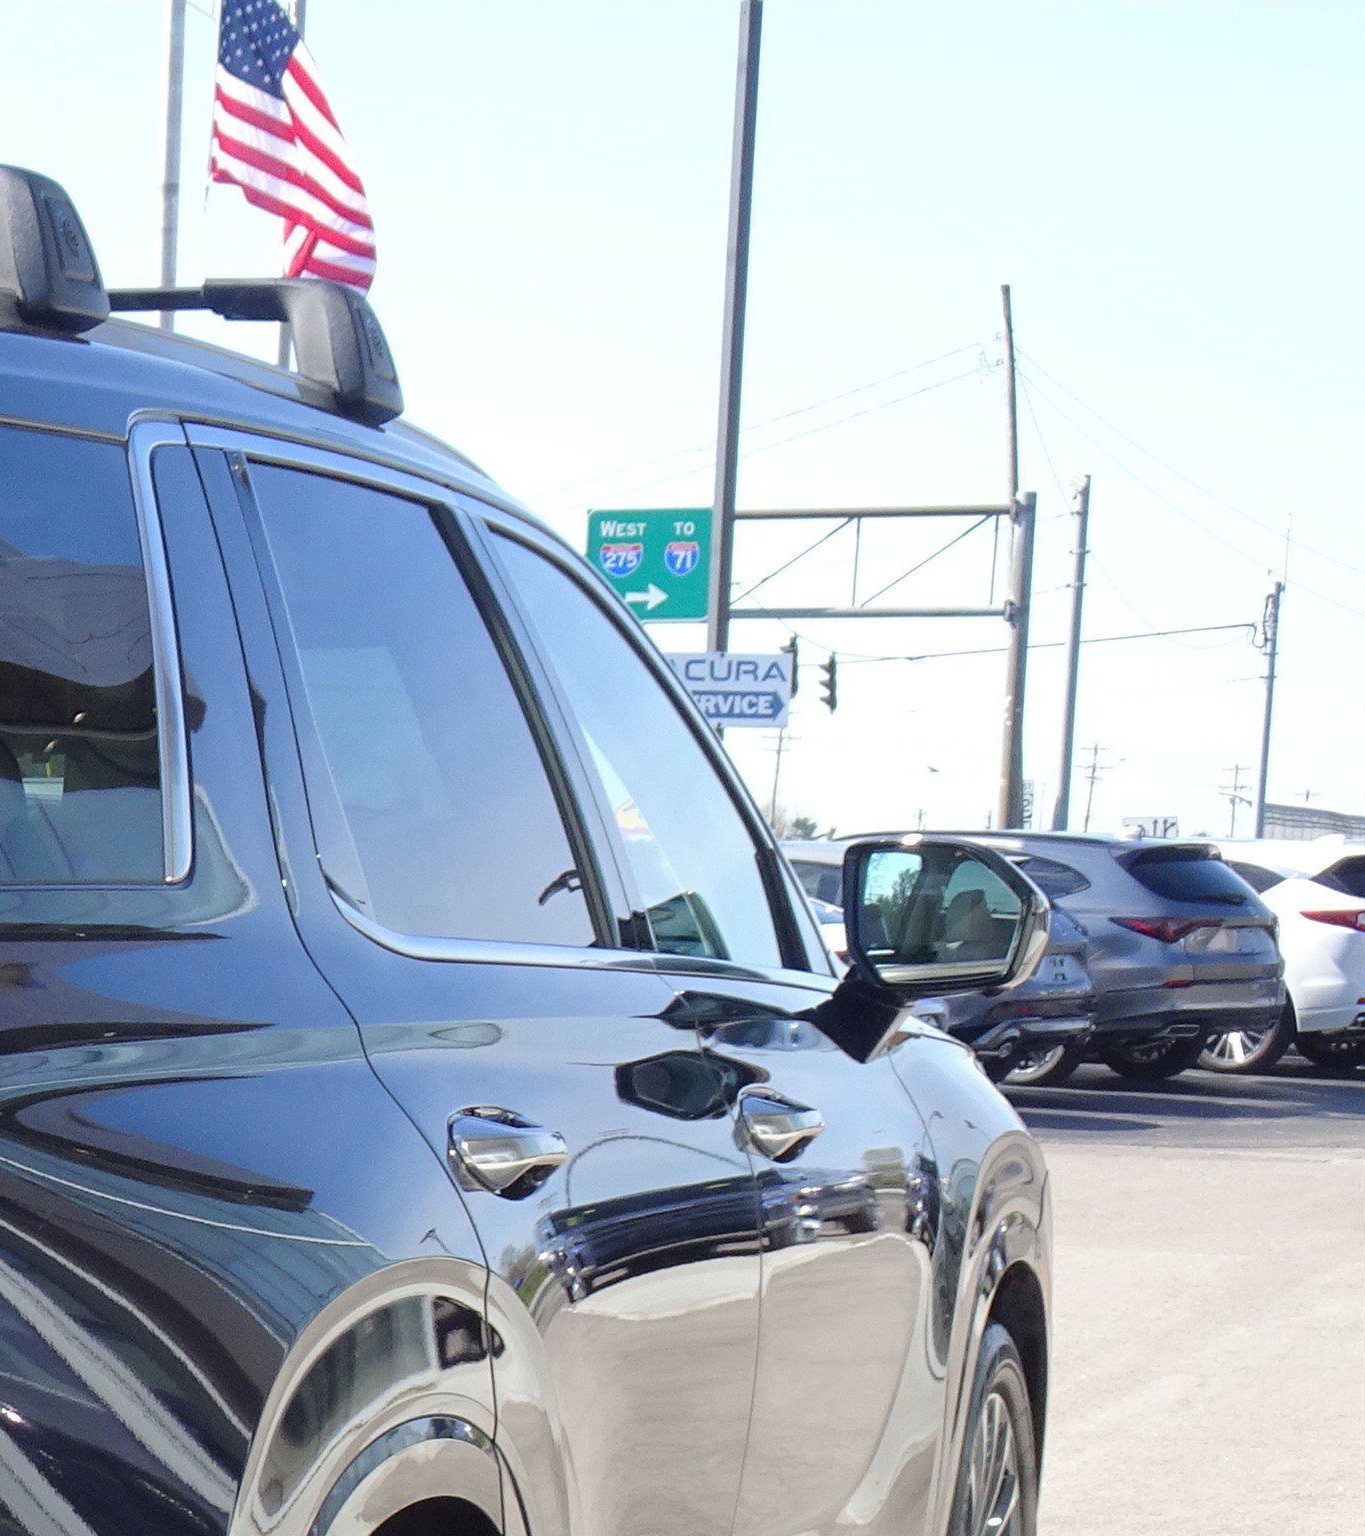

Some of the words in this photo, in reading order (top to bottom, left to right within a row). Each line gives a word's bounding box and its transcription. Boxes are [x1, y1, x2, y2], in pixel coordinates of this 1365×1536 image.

[600, 521, 647, 537] WEST
[673, 521, 695, 536] TO
[605, 551, 638, 568] 275
[673, 551, 693, 569] 71
[694, 694, 775, 715] RVICE
